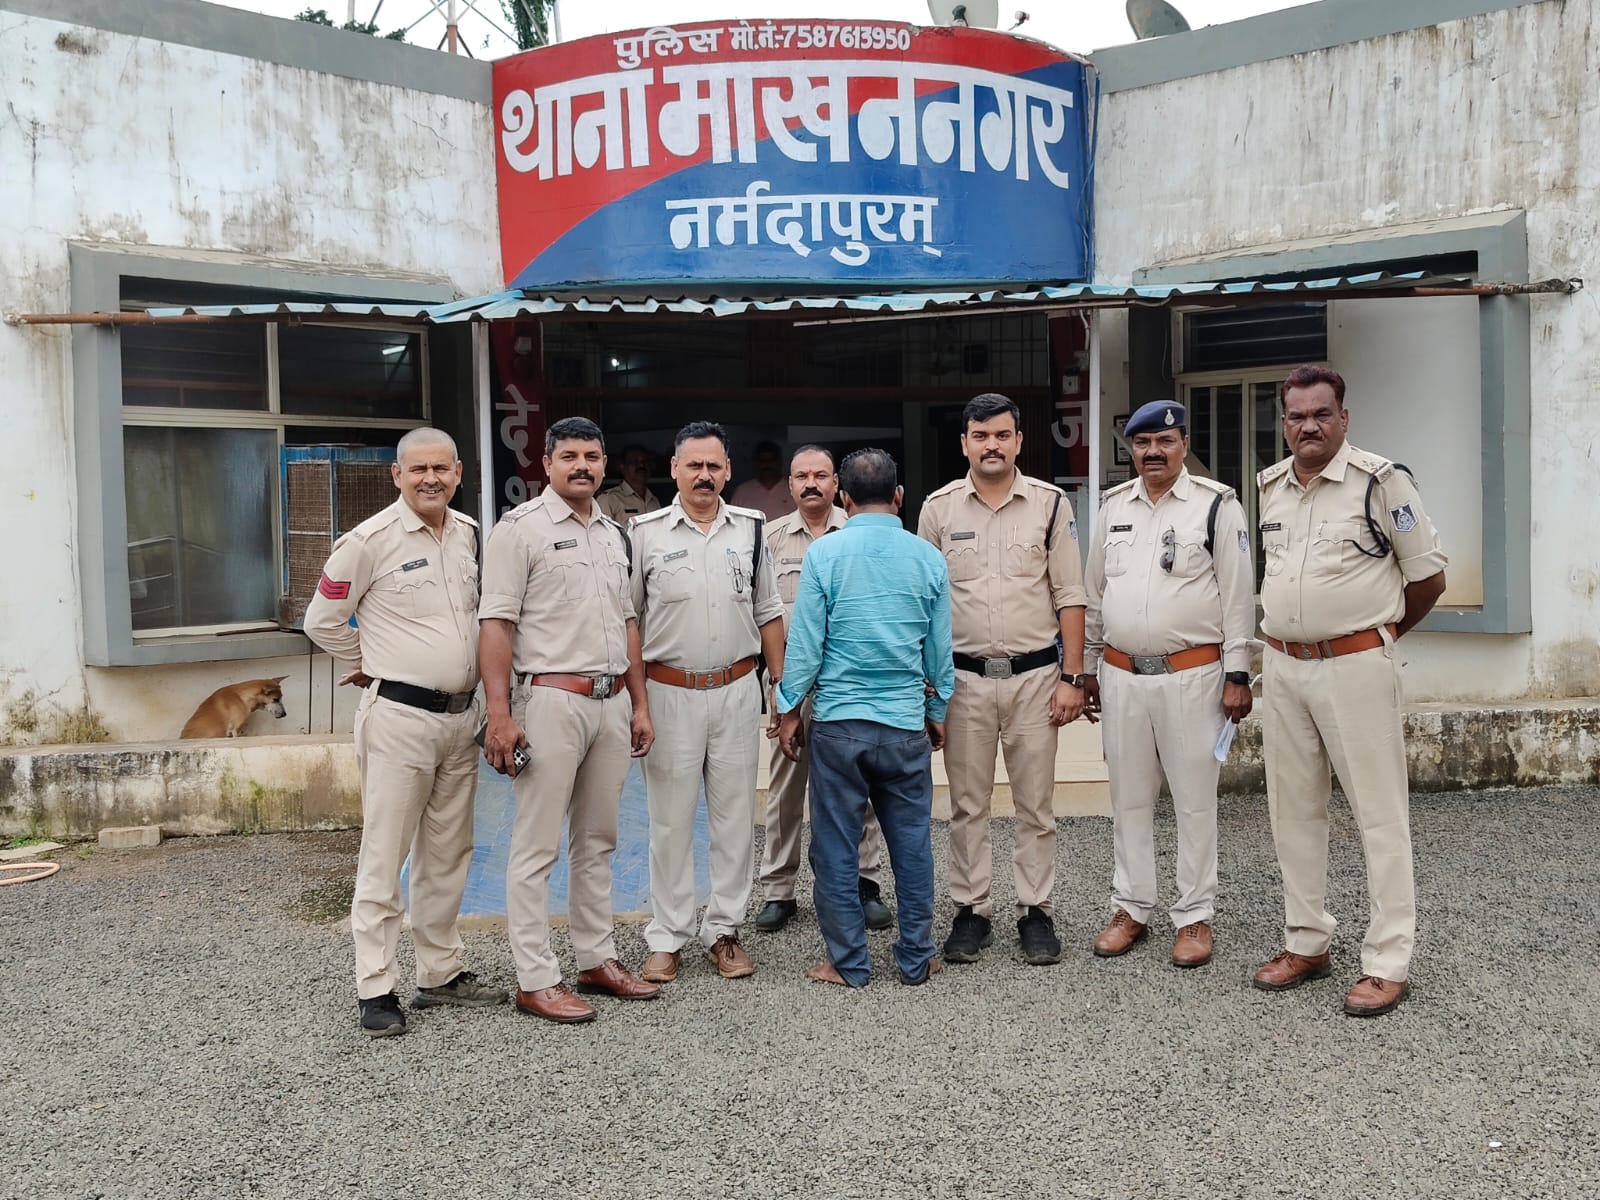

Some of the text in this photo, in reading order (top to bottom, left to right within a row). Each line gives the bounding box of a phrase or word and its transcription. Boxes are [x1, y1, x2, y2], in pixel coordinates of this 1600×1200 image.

[613, 26, 724, 69] पुलिस
[502, 68, 654, 181] थाना
[665, 180, 942, 266] नर्मदापुरम्
